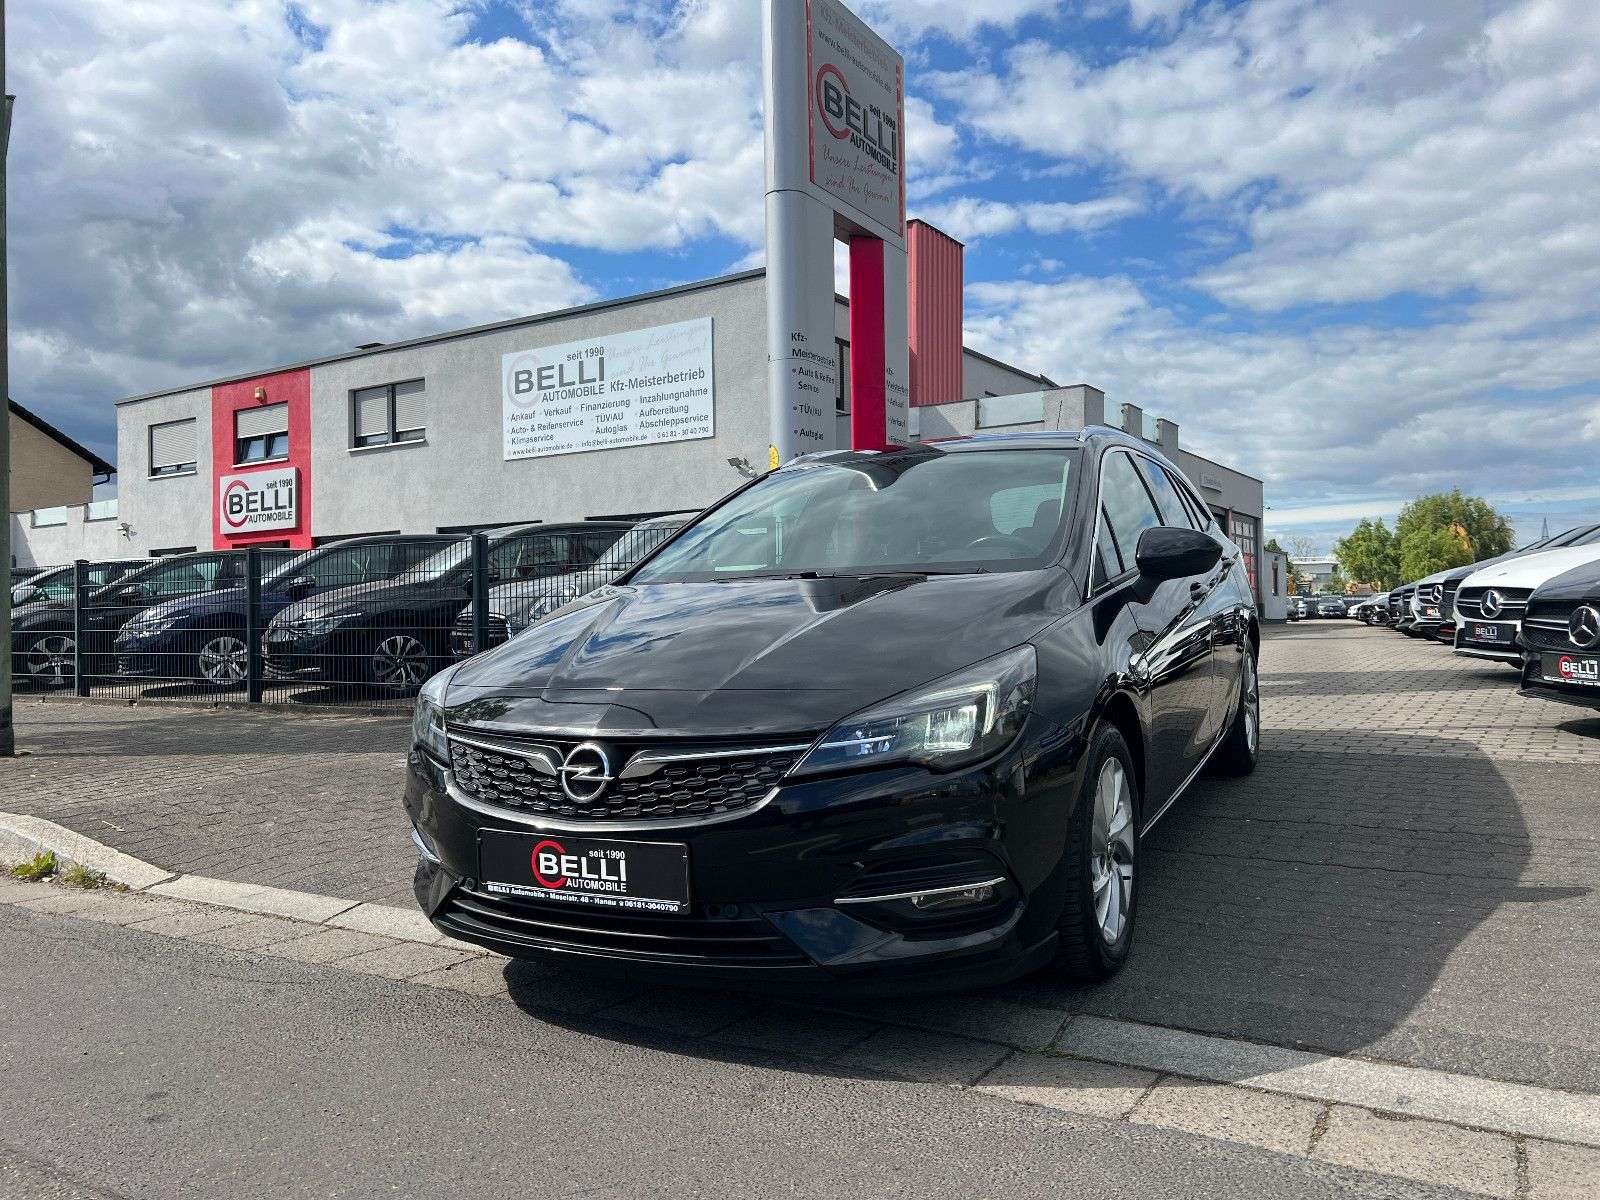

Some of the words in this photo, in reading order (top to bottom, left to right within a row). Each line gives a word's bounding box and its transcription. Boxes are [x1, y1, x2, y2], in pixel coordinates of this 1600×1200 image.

[824, 80, 896, 161] BELLI
[869, 104, 881, 119] seit
[883, 113, 896, 130] 1990
[850, 132, 897, 175] AUTOMOBILE
[791, 332, 808, 342] Kfz-
[566, 350, 582, 361] seit
[584, 346, 604, 358] 1990
[514, 356, 604, 394] BELLI
[610, 366, 705, 393] Kfz-Meisterbetrieb
[542, 383, 605, 402] AUTOMOBILE
[639, 386, 709, 404] Inzahlungnahme
[511, 410, 535, 422] Ankauf
[543, 405, 572, 417] Verkauf
[580, 399, 631, 412] Finanzierung
[639, 404, 689, 418] Aufbereitung
[511, 426, 529, 435] Auto-
[530, 424, 536, 432] &
[537, 418, 584, 431] Reifenservice
[595, 424, 628, 435] Autoglas
[639, 414, 709, 429] Abschleppservice
[511, 434, 554, 445] Klimaservice
[266, 480, 278, 490] seit
[279, 479, 293, 488] 1990
[229, 487, 293, 515] BELLI
[248, 511, 293, 523] AUTOMOBILE
[1561, 661, 1598, 675] BELLI
[589, 850, 604, 858] seit
[606, 850, 625, 859] 1990
[539, 852, 627, 882] BELLI
[565, 878, 627, 893] AUTOMOBILE
[511, 887, 545, 898] Automobile
[550, 892, 579, 902] Moselstr.
[594, 898, 617, 906] Hanau
